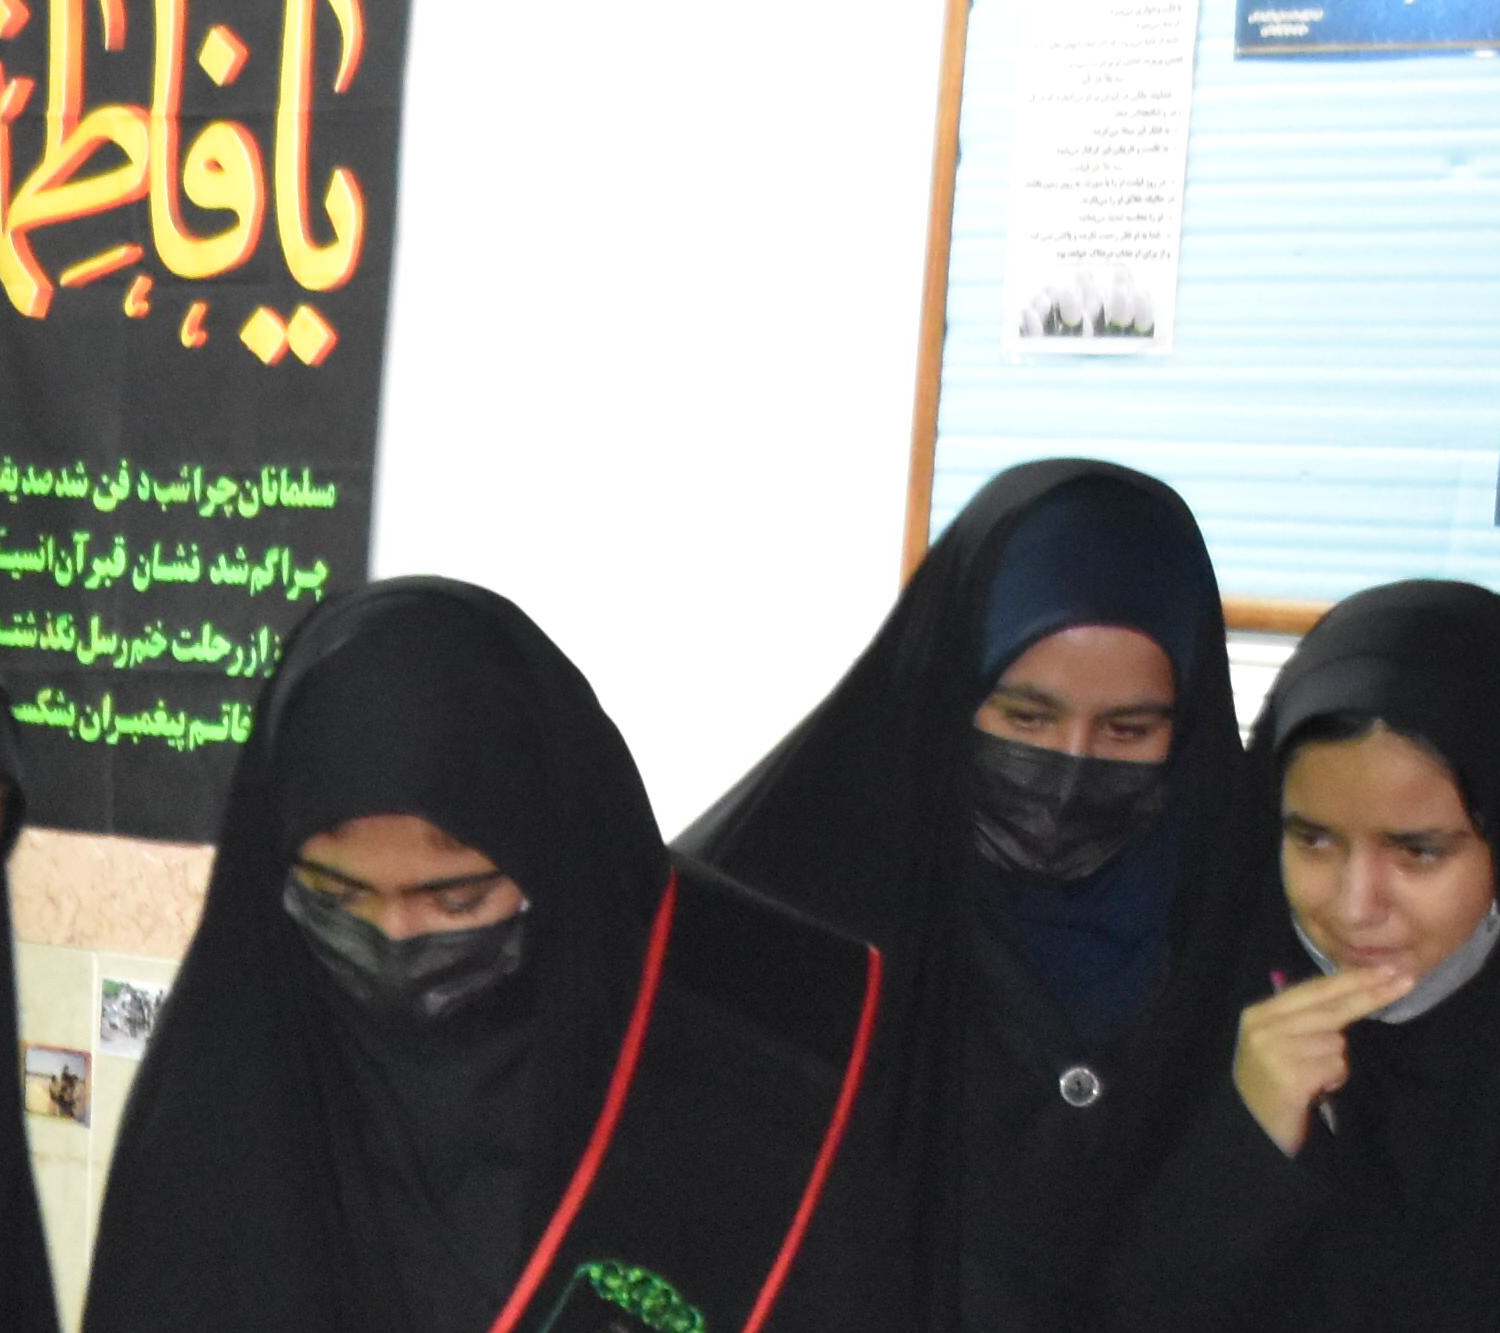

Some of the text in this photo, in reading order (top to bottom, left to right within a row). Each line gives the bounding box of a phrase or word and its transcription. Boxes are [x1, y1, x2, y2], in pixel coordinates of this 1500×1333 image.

[55, 459, 88, 498] شد
[153, 464, 191, 513] شب
[193, 466, 238, 519] چرا
[238, 466, 335, 518] مسلمانان
[55, 530, 91, 588] آن
[84, 534, 126, 590] قبر
[132, 541, 201, 592] نشان
[209, 545, 250, 585] شد
[250, 546, 280, 598] گم
[281, 546, 328, 602] چرا
[77, 612, 128, 669] رسل
[130, 618, 168, 670] ختم
[172, 618, 244, 678] رحلت
[79, 692, 187, 752] پیغمبران
